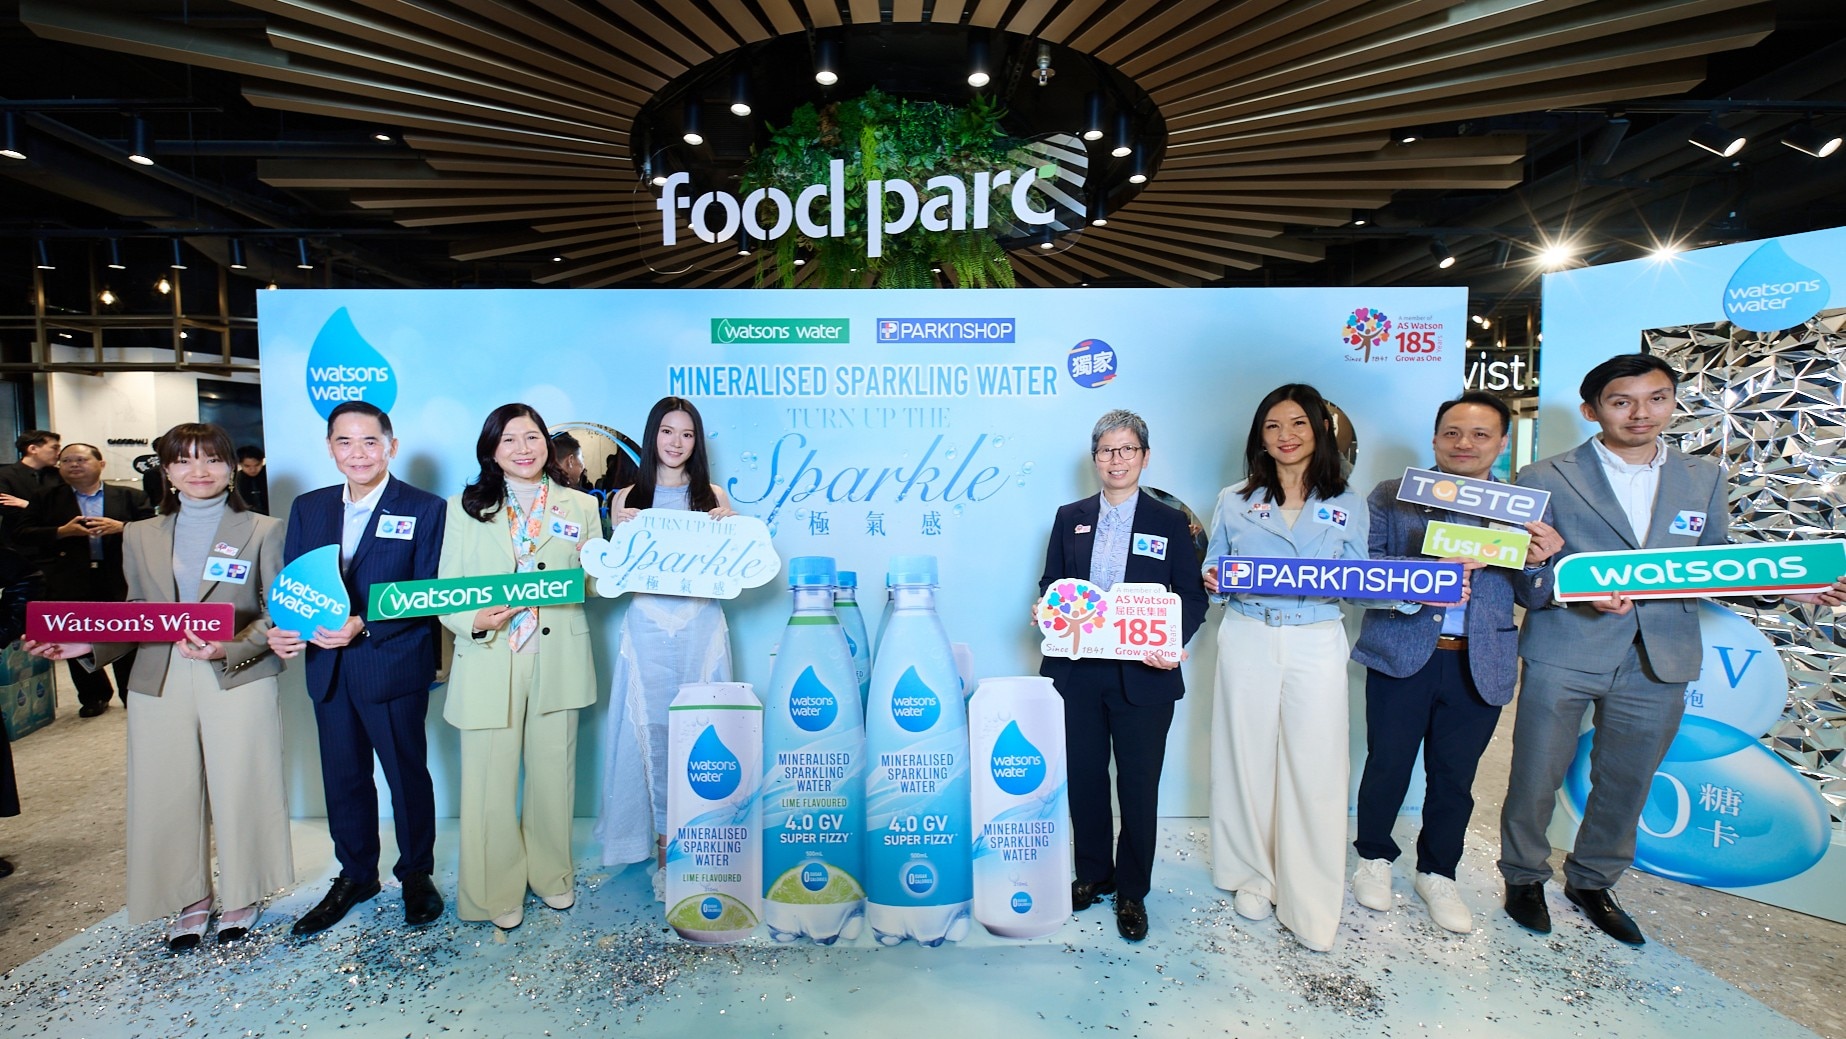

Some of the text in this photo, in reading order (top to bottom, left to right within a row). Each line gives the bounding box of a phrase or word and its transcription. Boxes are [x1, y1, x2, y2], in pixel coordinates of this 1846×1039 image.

[657, 159, 1056, 258] food parc
[1729, 279, 1820, 300] watsons
[1728, 297, 1792, 314] water
[724, 324, 843, 340] watsons water
[1395, 331, 1436, 353] 185
[1072, 351, 1114, 378] 獨家
[310, 364, 389, 382] watsons
[669, 366, 1057, 396] MINERALISED SPARKLING WATER
[311, 383, 367, 401] water
[787, 408, 951, 429] TURN UP THE
[727, 433, 1010, 525] Sparkle
[641, 515, 737, 536] TURN UP THE
[1432, 528, 1518, 562] fusion
[600, 529, 766, 586] Sparkle
[1590, 556, 1808, 587] watsons
[279, 574, 346, 616] watsons
[390, 579, 573, 611] watsons water
[1115, 595, 1176, 605] AS Watson
[271, 588, 321, 620] water
[1115, 606, 1167, 617] 屈臣氏集團
[42, 612, 221, 632] Watson's Wine
[1113, 618, 1168, 647] 185
[1169, 624, 1177, 647] Years
[1046, 643, 1104, 655] Since 1841
[1115, 647, 1141, 656] Grow
[791, 696, 833, 706] watsons
[893, 696, 937, 707] watsons
[791, 706, 822, 716] water
[894, 706, 924, 717] water
[690, 760, 736, 771] watsons
[778, 753, 850, 766] MINERALISED
[881, 753, 954, 767] MINERALISED
[993, 755, 1041, 766] watsons
[690, 771, 723, 783] water
[784, 766, 844, 779] SPARKLING
[888, 767, 948, 780] SPARKLING
[993, 766, 1028, 778] water
[797, 779, 832, 792] WATER
[900, 780, 936, 793] WATER
[782, 799, 847, 808] LIME FLAVOURED
[785, 814, 844, 831] 4.0 GV
[888, 815, 948, 832] 4.0 GV
[983, 821, 1055, 836] MINERALISED
[677, 827, 748, 840] MINERALISED
[779, 833, 817, 844] SUPER
[884, 834, 921, 846] SUPER
[683, 841, 741, 853] SPARKLING
[990, 836, 1049, 849] SPARKLING
[694, 854, 729, 866] WATER
[1003, 849, 1037, 862] WATER
[682, 873, 742, 882] LIME FLAVOURED
[804, 871, 810, 883] 0
[908, 873, 915, 885] 0
